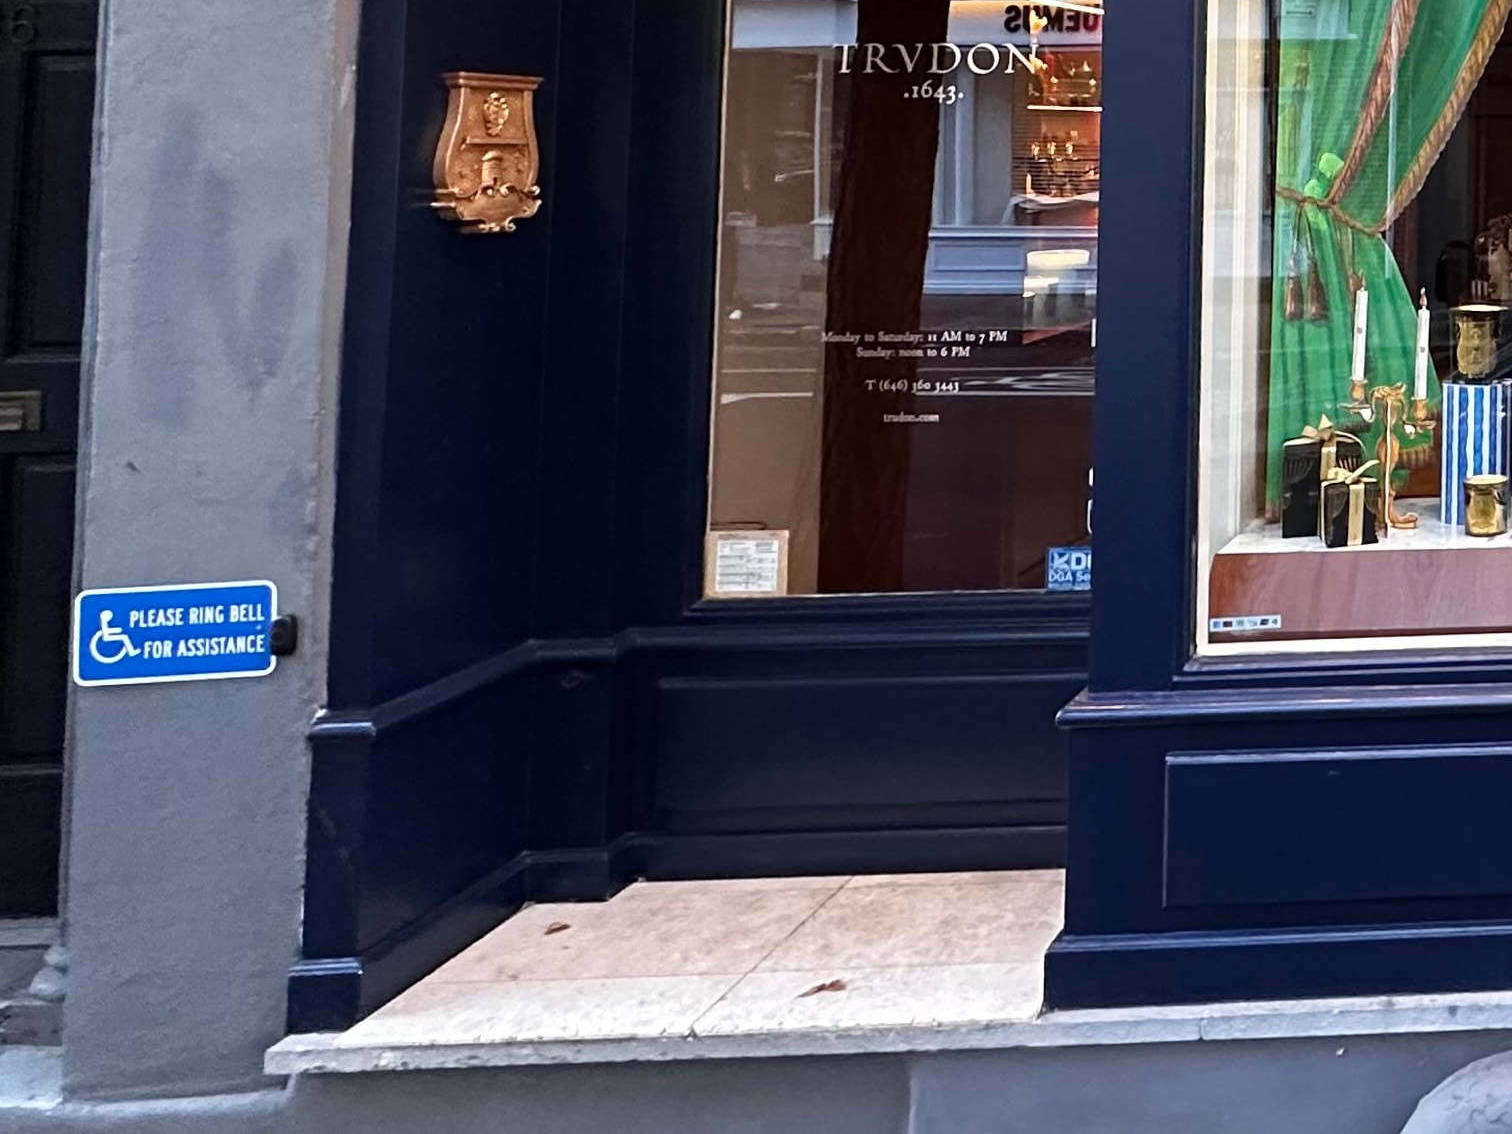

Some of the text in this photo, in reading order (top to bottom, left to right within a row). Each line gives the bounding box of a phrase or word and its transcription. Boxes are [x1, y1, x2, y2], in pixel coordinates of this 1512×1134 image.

[832, 42, 1039, 75] TRVDON
[821, 331, 861, 345] Monday
[864, 333, 876, 343] to
[878, 331, 924, 345] Saturday:
[941, 330, 962, 342] AM
[965, 333, 976, 342] to
[979, 333, 986, 345] 7
[988, 330, 1008, 342] PM
[856, 346, 970, 360] Sunday: noon to 6 PM
[865, 379, 876, 391] T
[879, 378, 908, 393] (646)
[129, 603, 265, 628] PLEASE RING BELL
[143, 634, 265, 659] FOR ASSISTANCE
